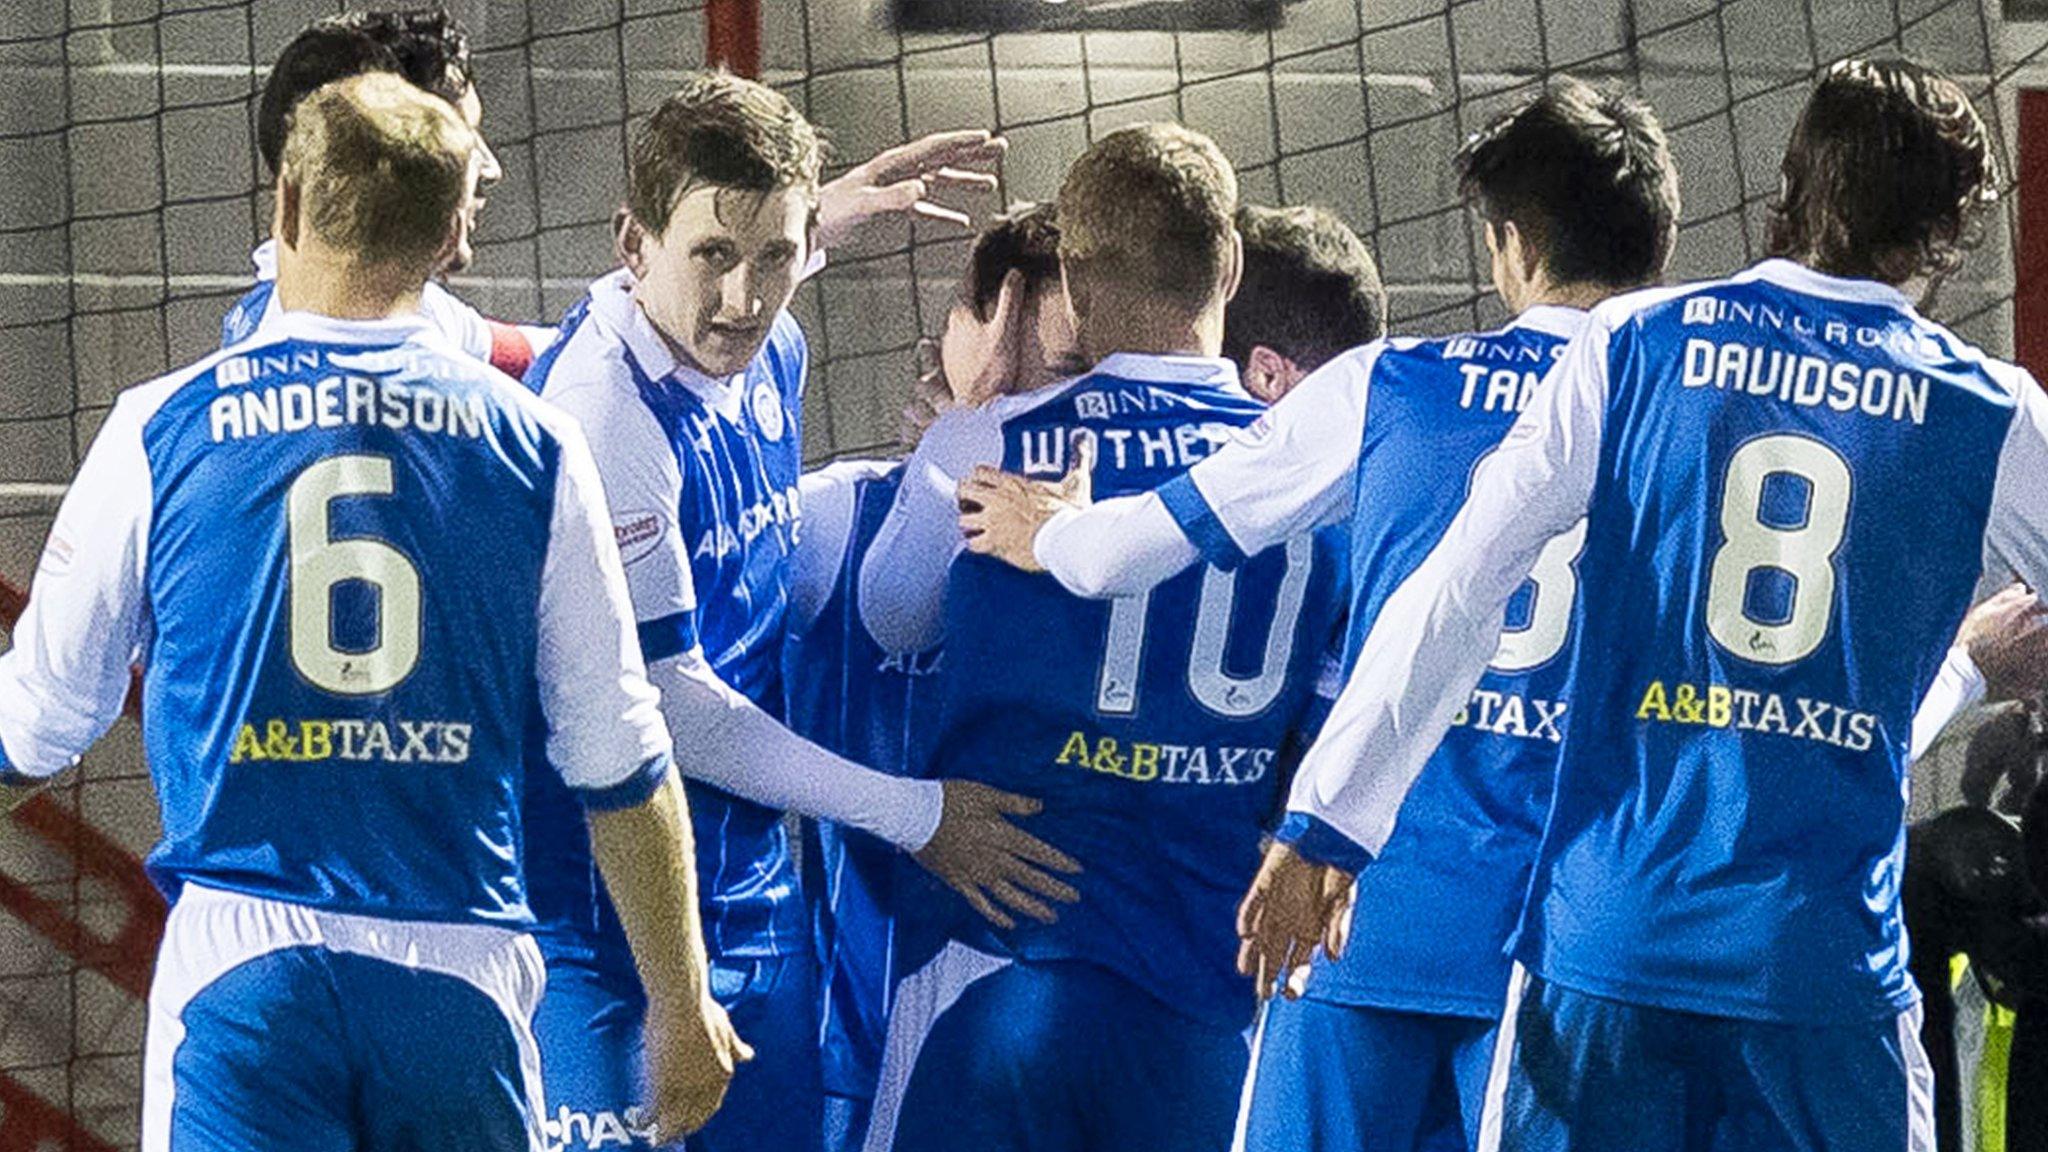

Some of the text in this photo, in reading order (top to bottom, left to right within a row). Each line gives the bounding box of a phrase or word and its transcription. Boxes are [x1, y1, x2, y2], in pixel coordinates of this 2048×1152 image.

[210, 376, 480, 443] ANDERSON
[1682, 338, 1929, 425] DAVIDSON
[288, 454, 422, 694] 6
[1706, 433, 1852, 665] 8
[1055, 731, 1276, 785] A&BTAXS
